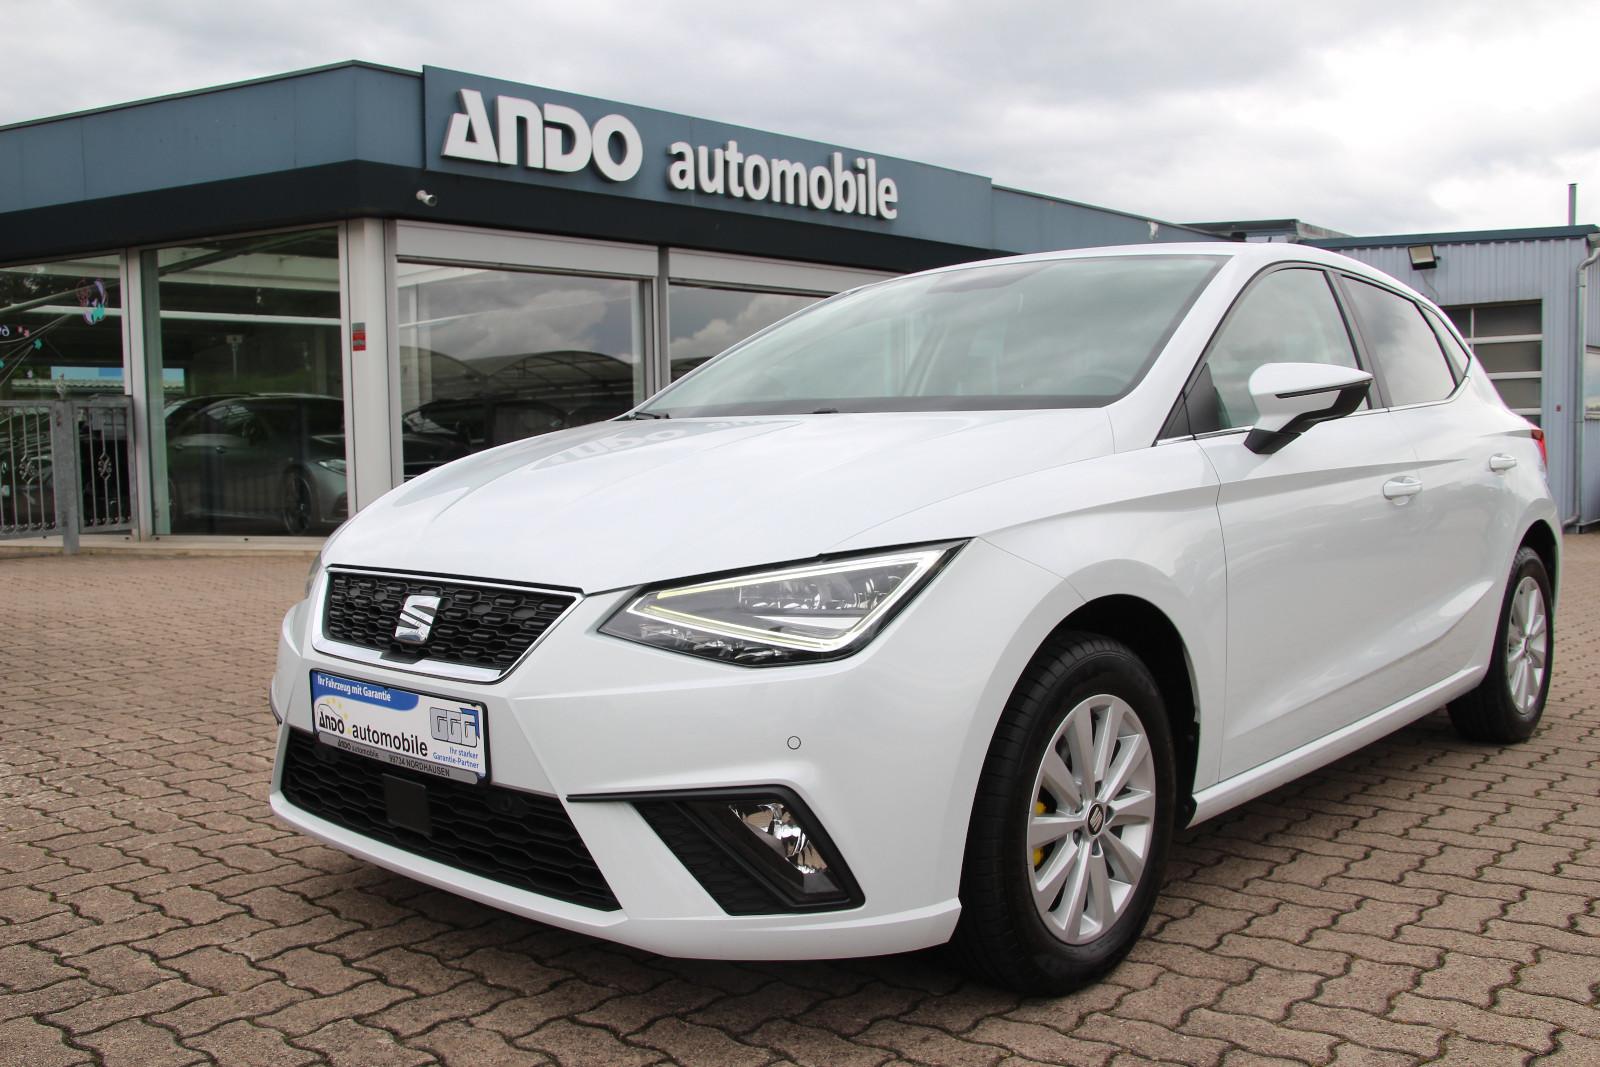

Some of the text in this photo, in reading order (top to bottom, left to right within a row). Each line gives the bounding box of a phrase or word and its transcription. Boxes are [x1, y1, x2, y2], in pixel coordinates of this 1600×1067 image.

[441, 88, 898, 220] ANDO automobile
[317, 674, 391, 701] Ihr Fahrzeug mit Garantie
[319, 711, 428, 757] ANDO automobile
[432, 752, 479, 769] Garantie-Partner
[449, 747, 479, 760] Ihr starker
[405, 759, 450, 777] NORDHAUSEN
